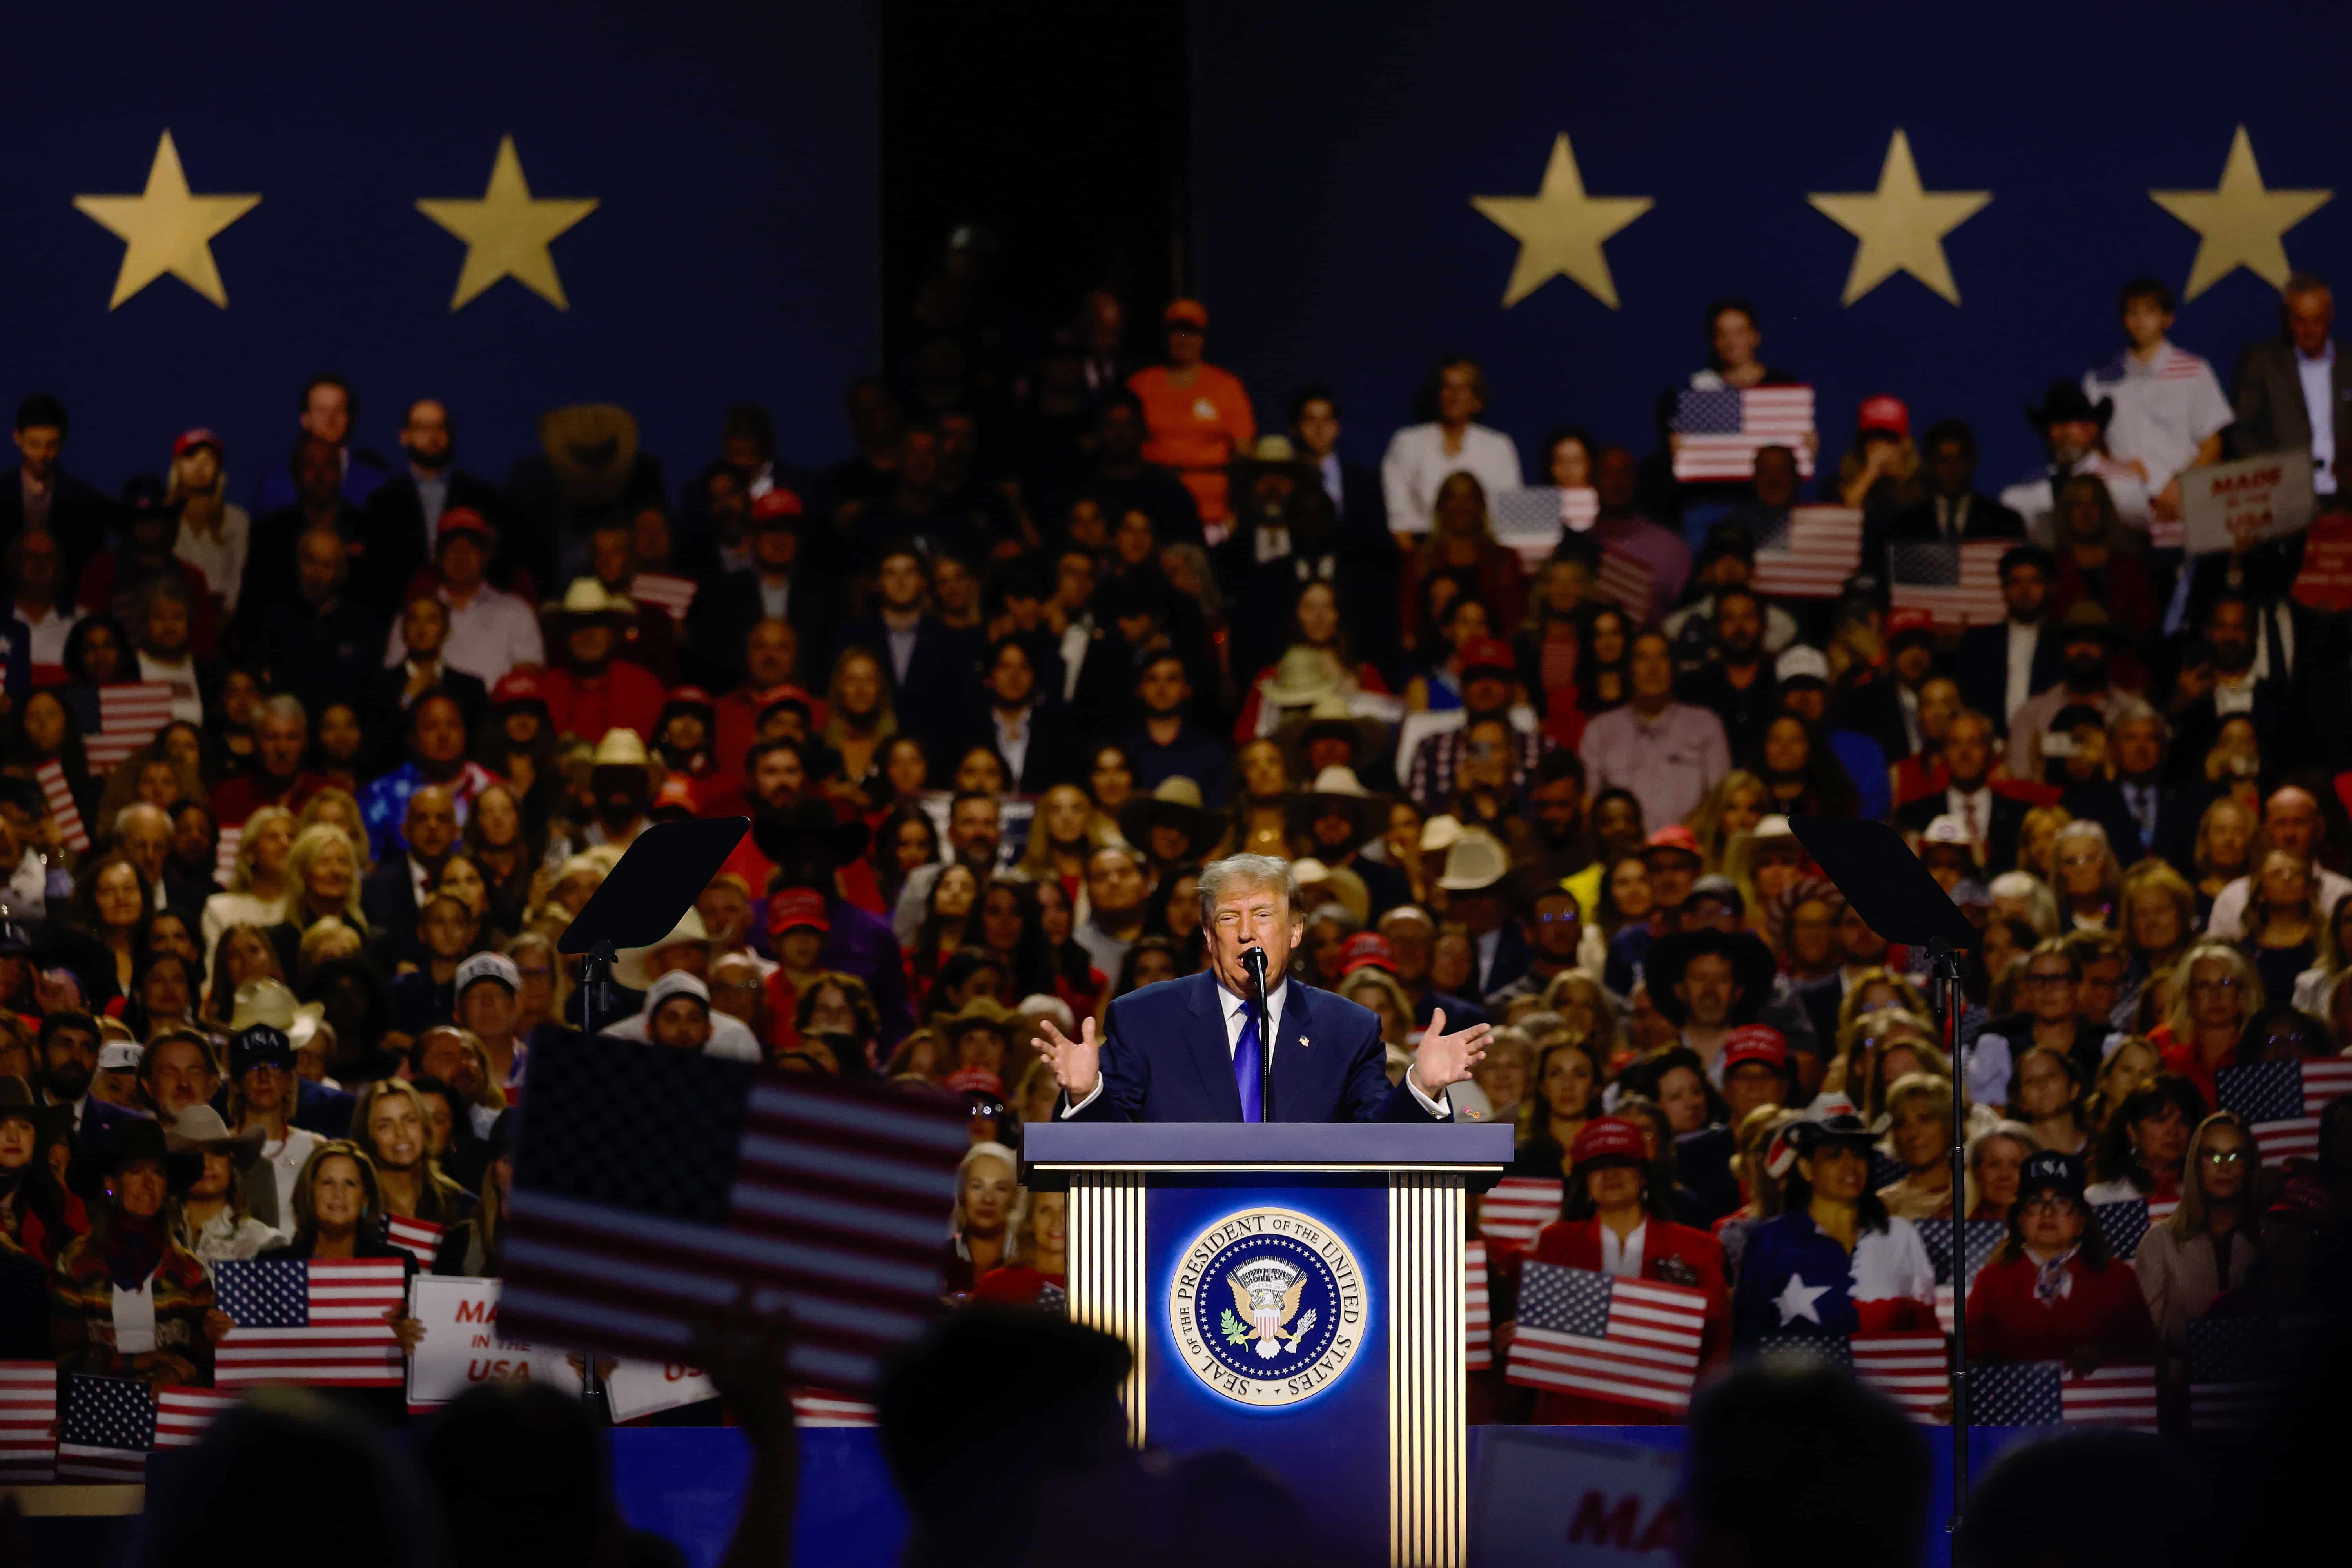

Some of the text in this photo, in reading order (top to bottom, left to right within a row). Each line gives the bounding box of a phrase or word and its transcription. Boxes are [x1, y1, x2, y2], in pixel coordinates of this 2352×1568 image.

[2030, 1159, 2068, 1178] USA
[456, 1300, 499, 1323] MA
[1178, 1216, 1359, 1395] SEAL OF THE PRESIDENT OF THE UNITED STATES
[472, 1334, 530, 1352] IN THE
[468, 1359, 528, 1381] USA
[1567, 1490, 1682, 1553] MA
